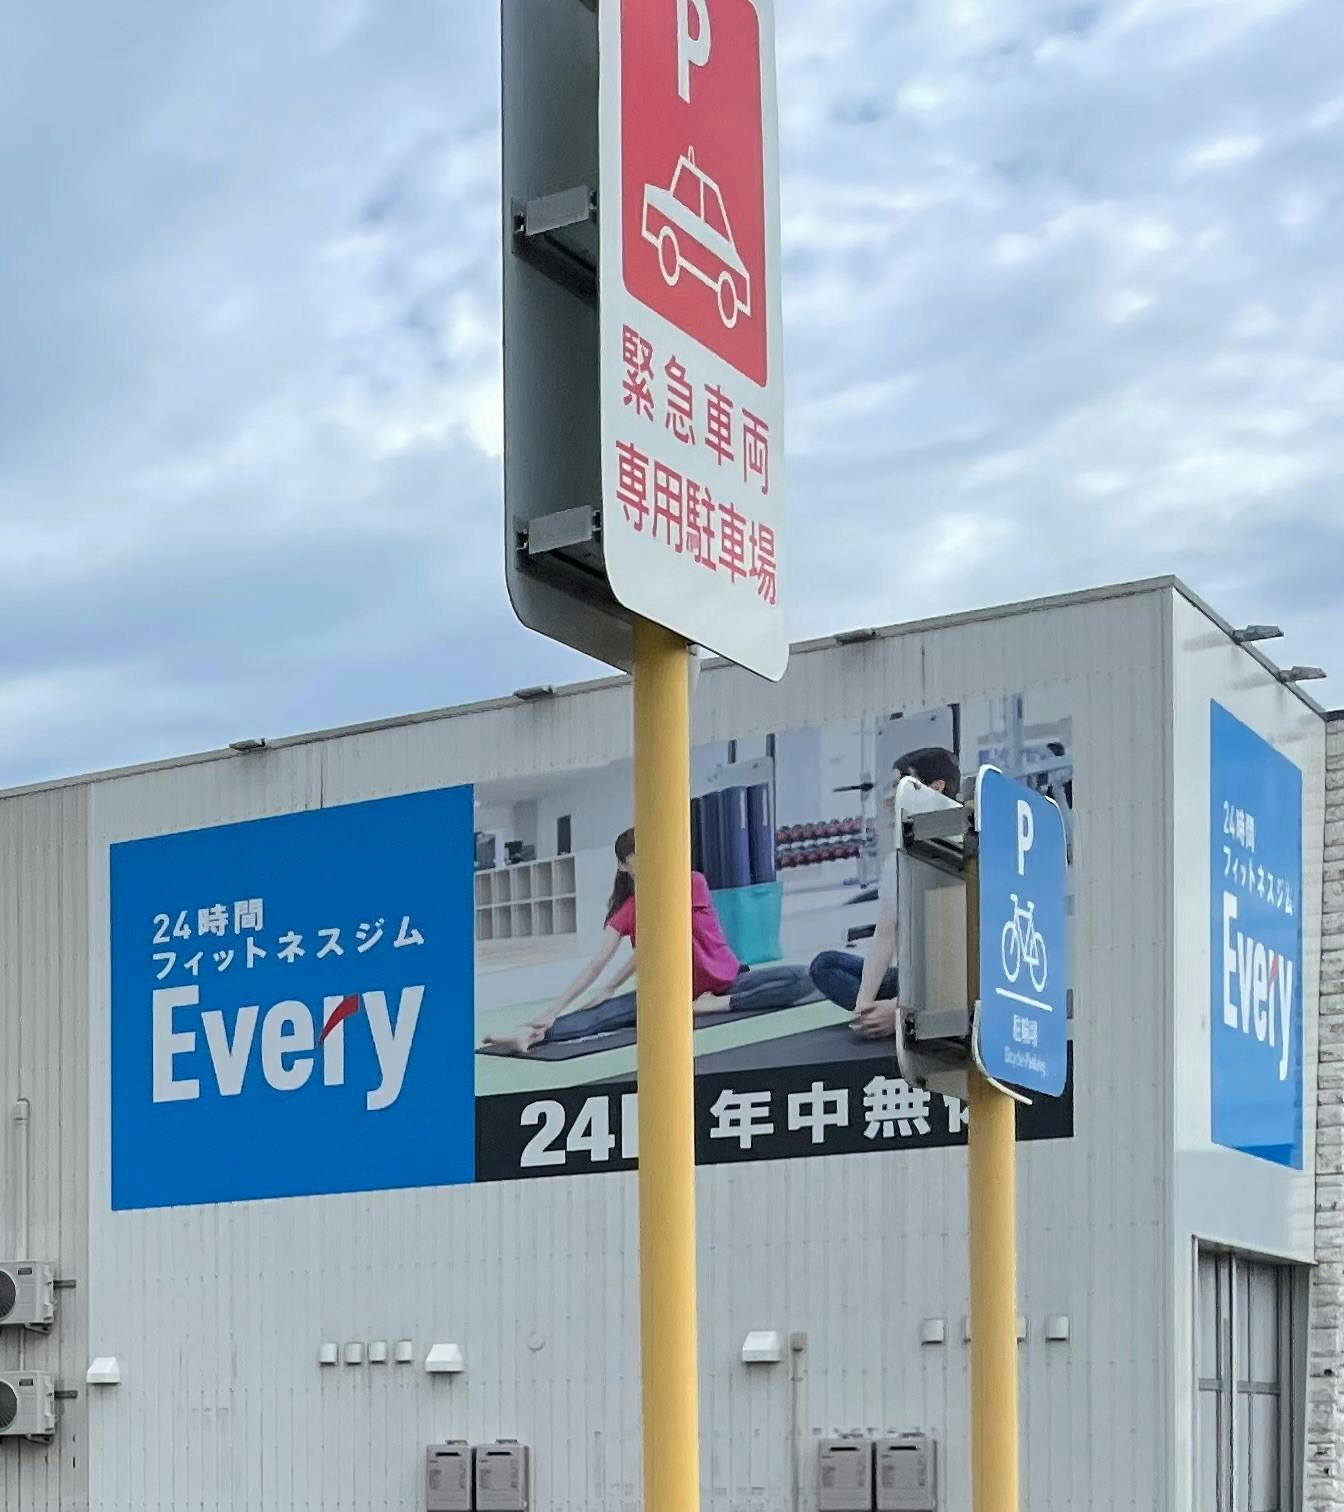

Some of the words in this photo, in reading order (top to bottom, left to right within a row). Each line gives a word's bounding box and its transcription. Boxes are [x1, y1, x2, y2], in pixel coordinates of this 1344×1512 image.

[676, 0, 712, 104] P
[622, 323, 771, 496] 緊急車両
[615, 440, 778, 606] 専用駐車場
[1017, 799, 1035, 876] P
[152, 897, 265, 945] 24時間
[152, 915, 426, 980] フィットネスジム
[1222, 889, 1294, 1082] Every
[152, 984, 426, 1111] Every
